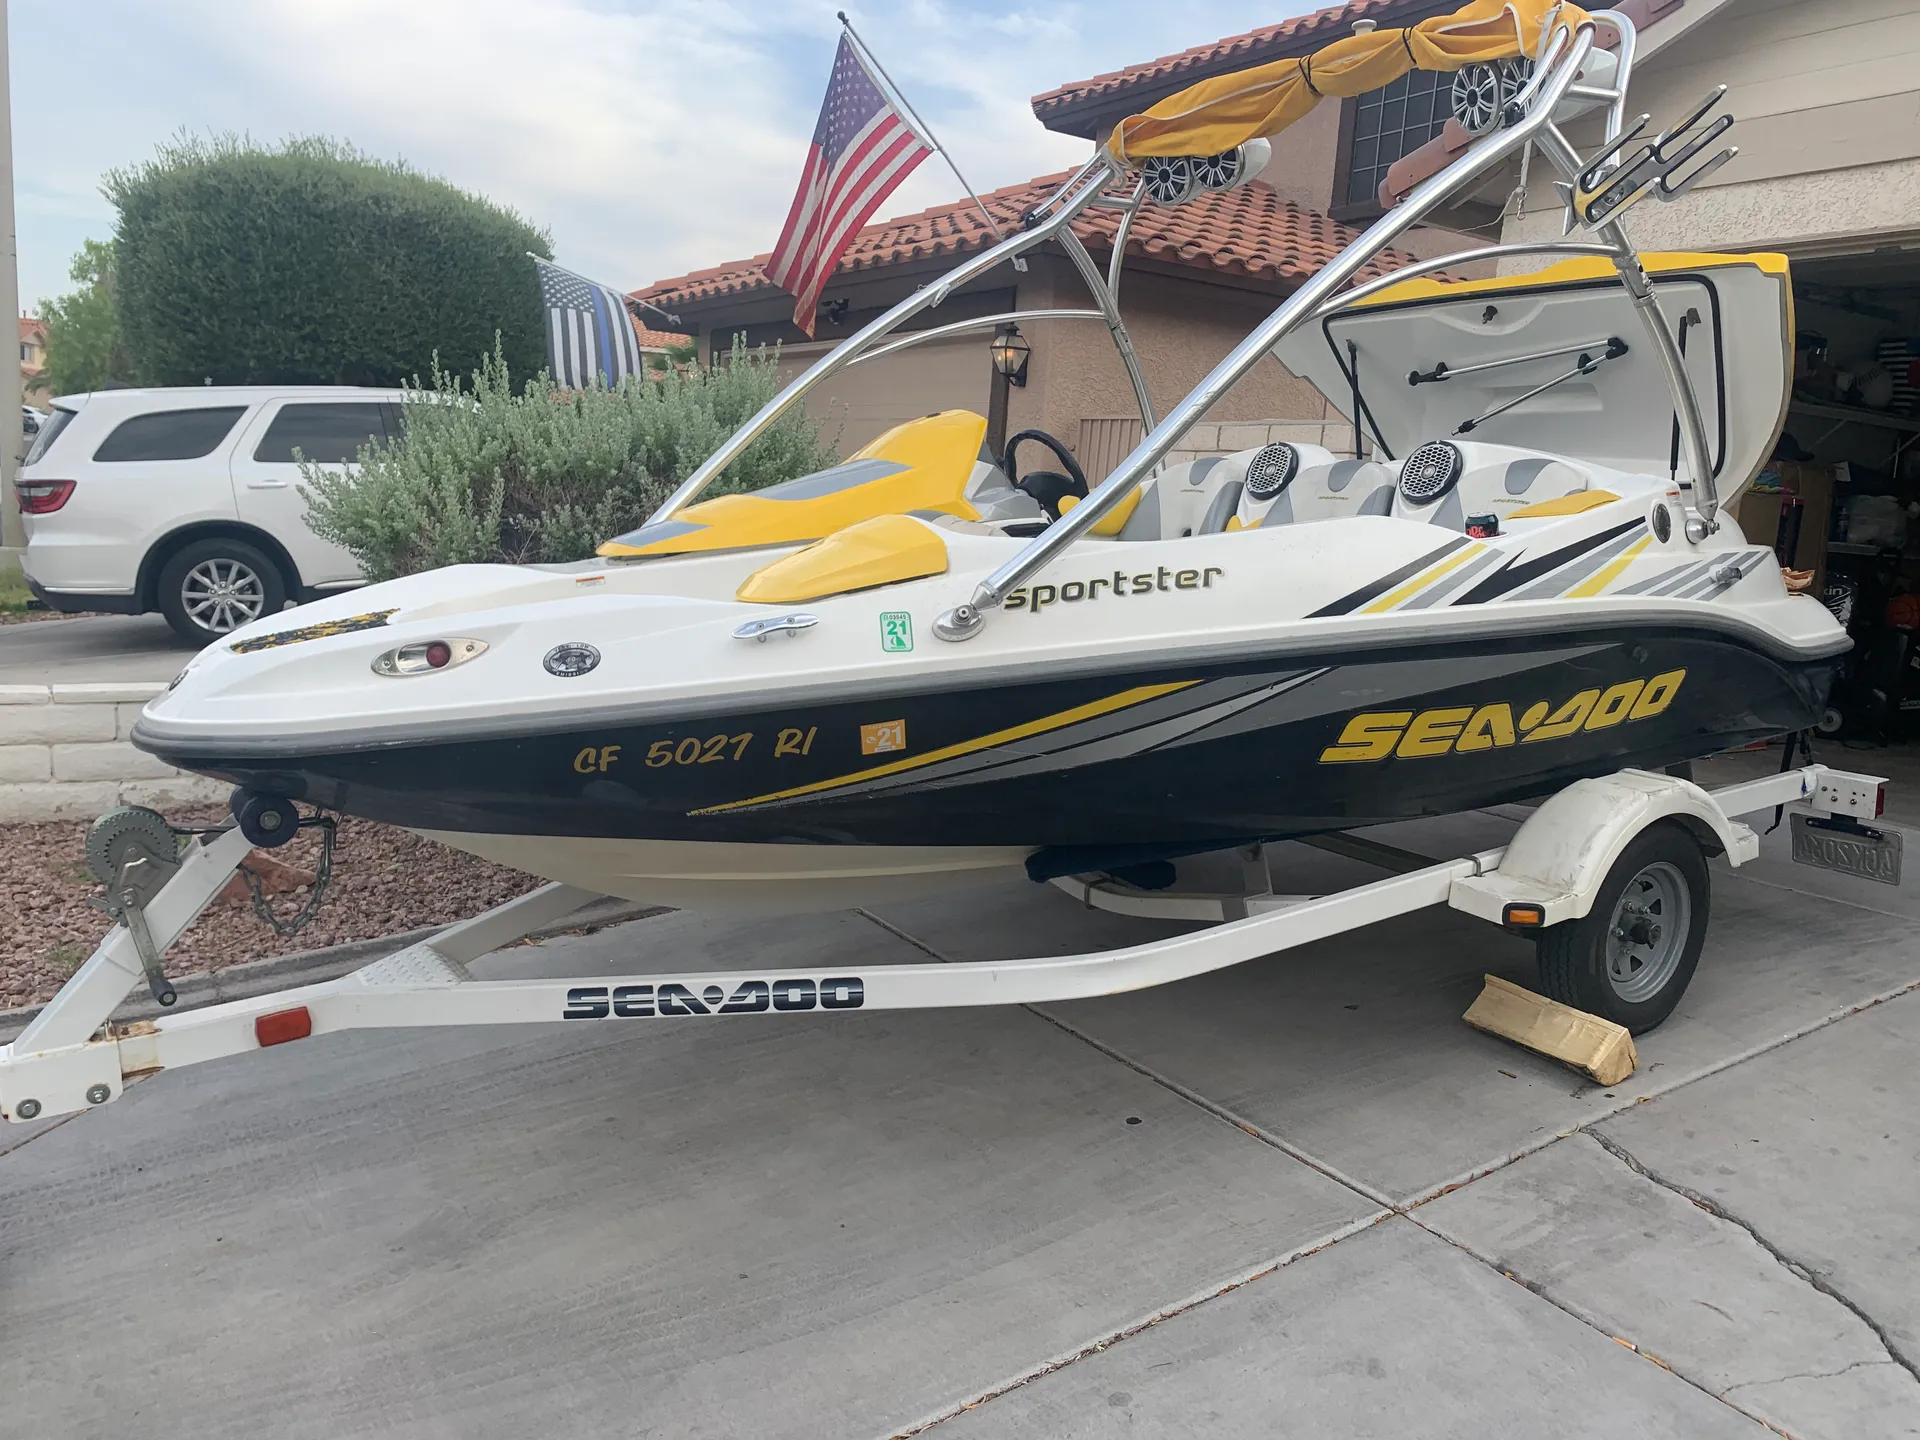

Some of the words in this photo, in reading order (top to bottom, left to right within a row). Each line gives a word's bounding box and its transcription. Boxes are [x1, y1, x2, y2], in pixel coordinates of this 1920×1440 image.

[1003, 565, 1224, 613] sportster
[886, 620, 907, 636] 21
[878, 726, 902, 746] 21
[573, 745, 622, 773] CF
[645, 732, 754, 768] 5027
